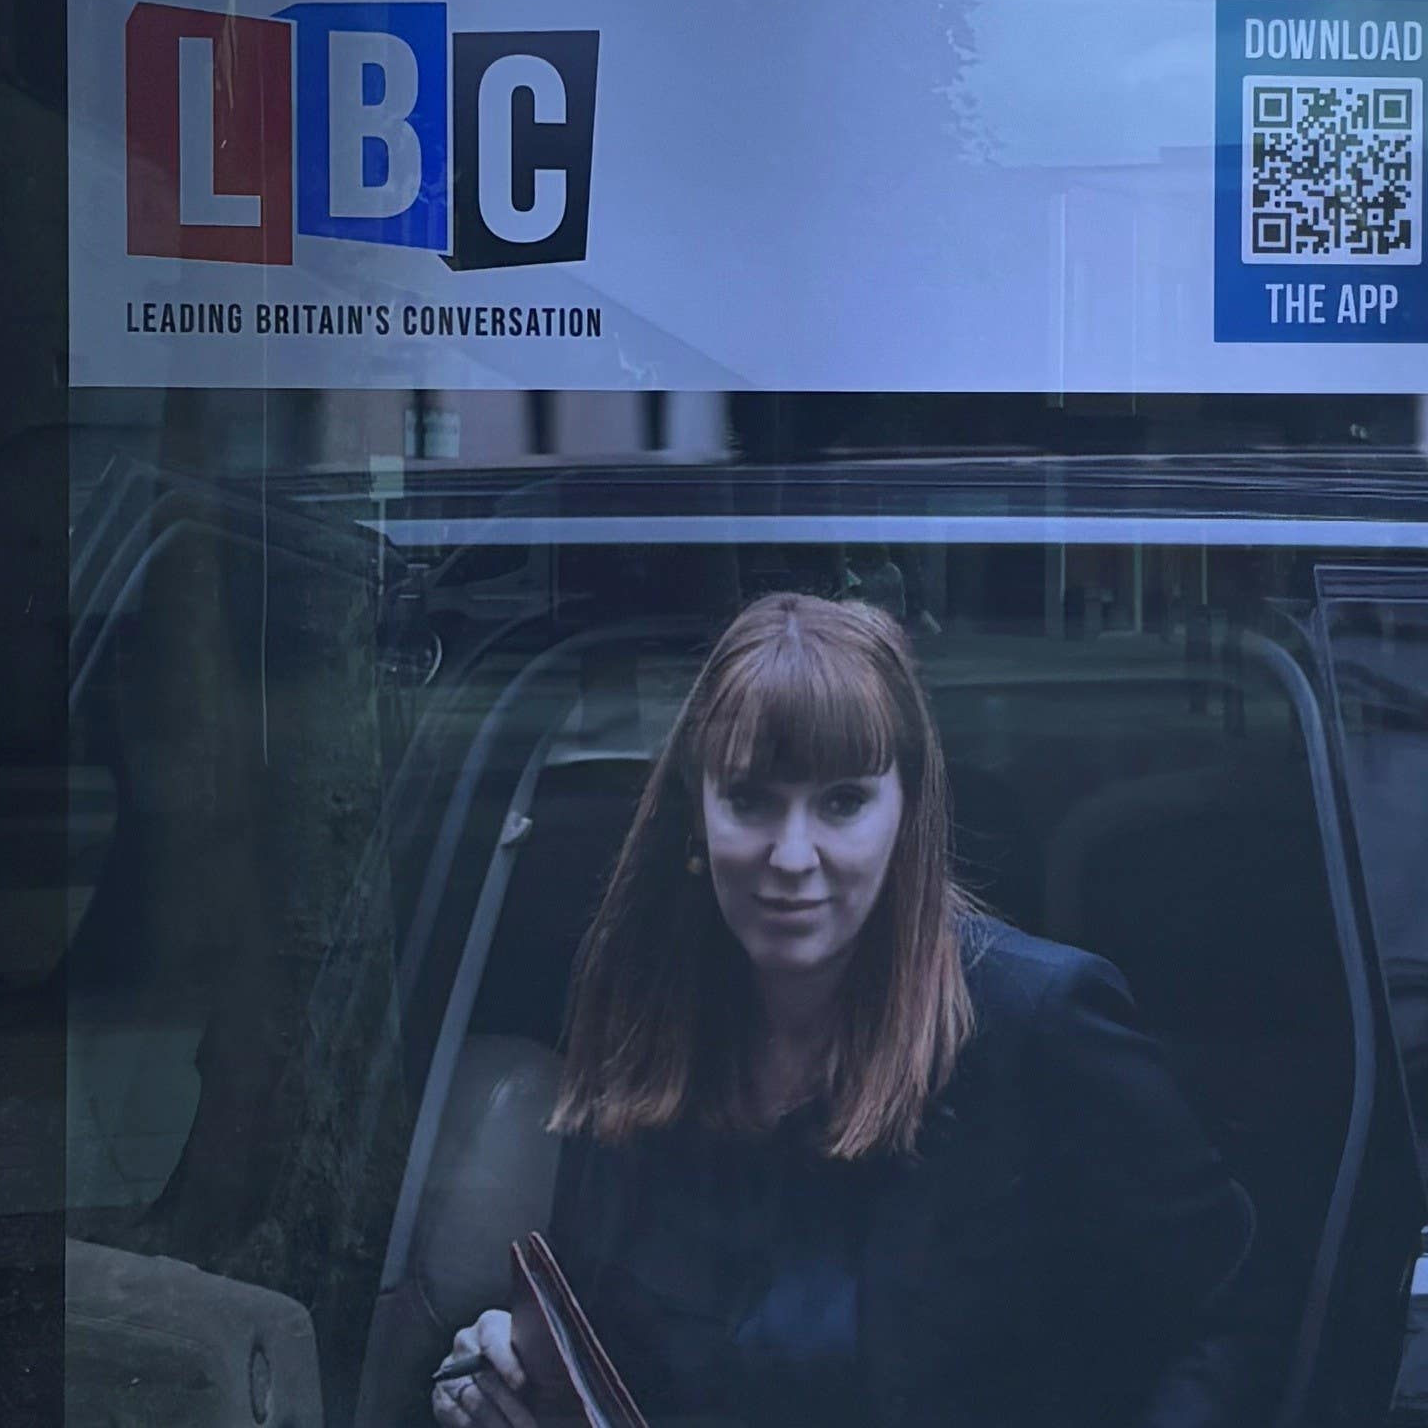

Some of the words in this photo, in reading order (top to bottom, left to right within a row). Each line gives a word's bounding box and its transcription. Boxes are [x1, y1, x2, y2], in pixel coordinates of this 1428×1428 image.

[1243, 17, 1423, 69] DOWNLOAD
[179, 24, 570, 244] LBC
[126, 301, 244, 335] LEADING
[256, 303, 391, 337] BRITAIN'S
[402, 305, 603, 338] CONVERSATION
[1264, 281, 1324, 323] THE
[1334, 284, 1399, 325] APP
